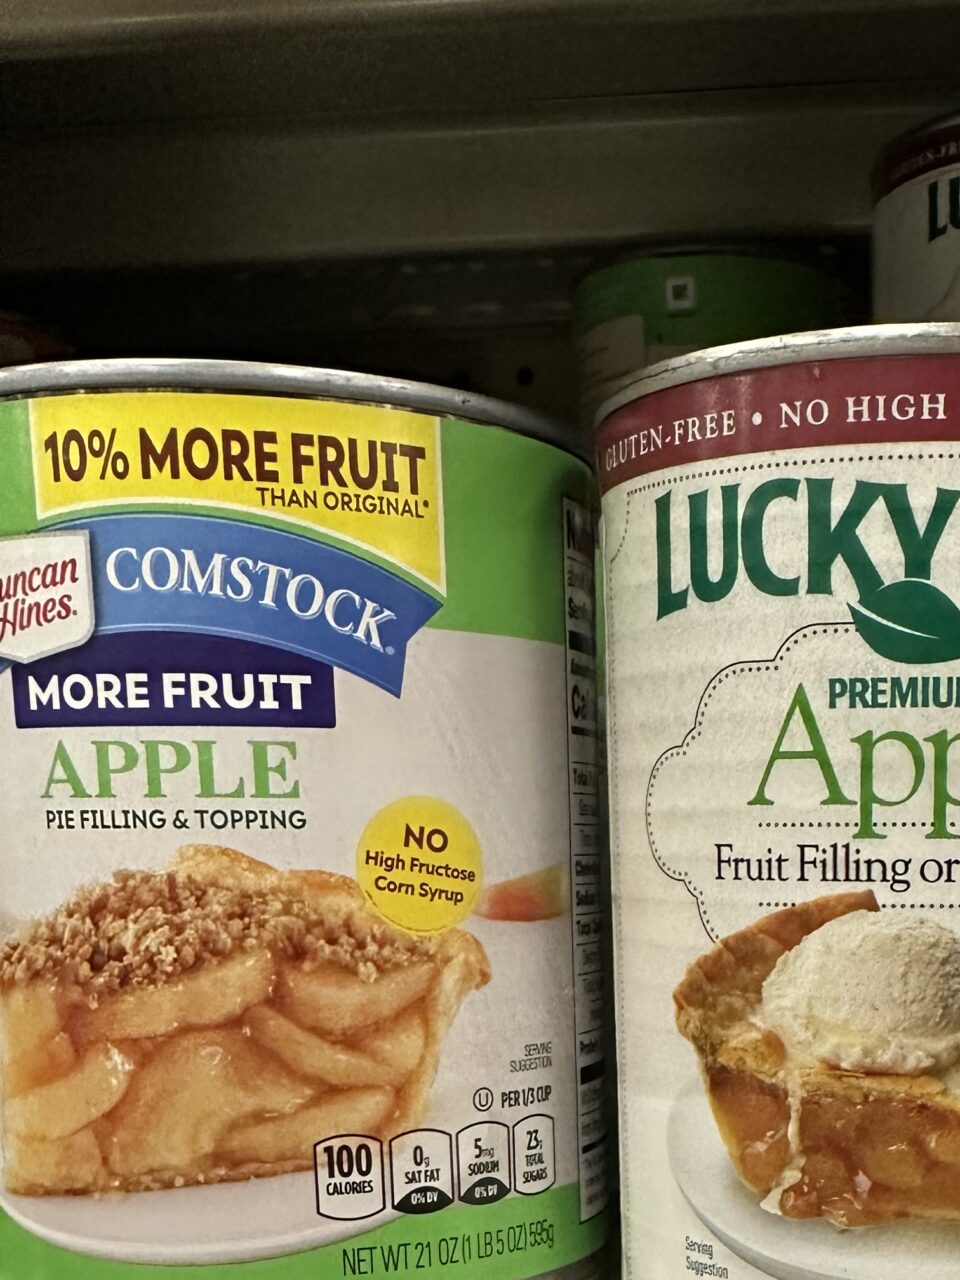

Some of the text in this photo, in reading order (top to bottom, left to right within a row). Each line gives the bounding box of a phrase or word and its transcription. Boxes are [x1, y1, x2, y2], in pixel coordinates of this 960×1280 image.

[605, 410, 737, 472] GLUTEN-FREE
[780, 399, 829, 428] NO
[846, 393, 947, 423] HIGH
[44, 427, 426, 495] 10% MORE FRUIT
[256, 486, 318, 509] THAN
[0, 558, 79, 603] uncan
[106, 546, 398, 655] COMSTOCK
[28, 673, 311, 711] MORE FRUIT
[41, 739, 300, 799] APPLE
[46, 810, 307, 830] PIE FILLING & TOPPING
[403, 824, 448, 853] NO
[365, 850, 476, 883] High Fructose
[714, 843, 789, 883] Fruit
[797, 843, 912, 892] Filling
[919, 855, 960, 884] or
[374, 875, 464, 905] Corn Syrup
[501, 1091, 520, 1108] PER
[323, 1143, 372, 1178] 100
[404, 1168, 441, 1184] SAT FAT
[326, 1180, 374, 1196] CALORIES
[342, 1231, 493, 1276] NET WT OZ LB
